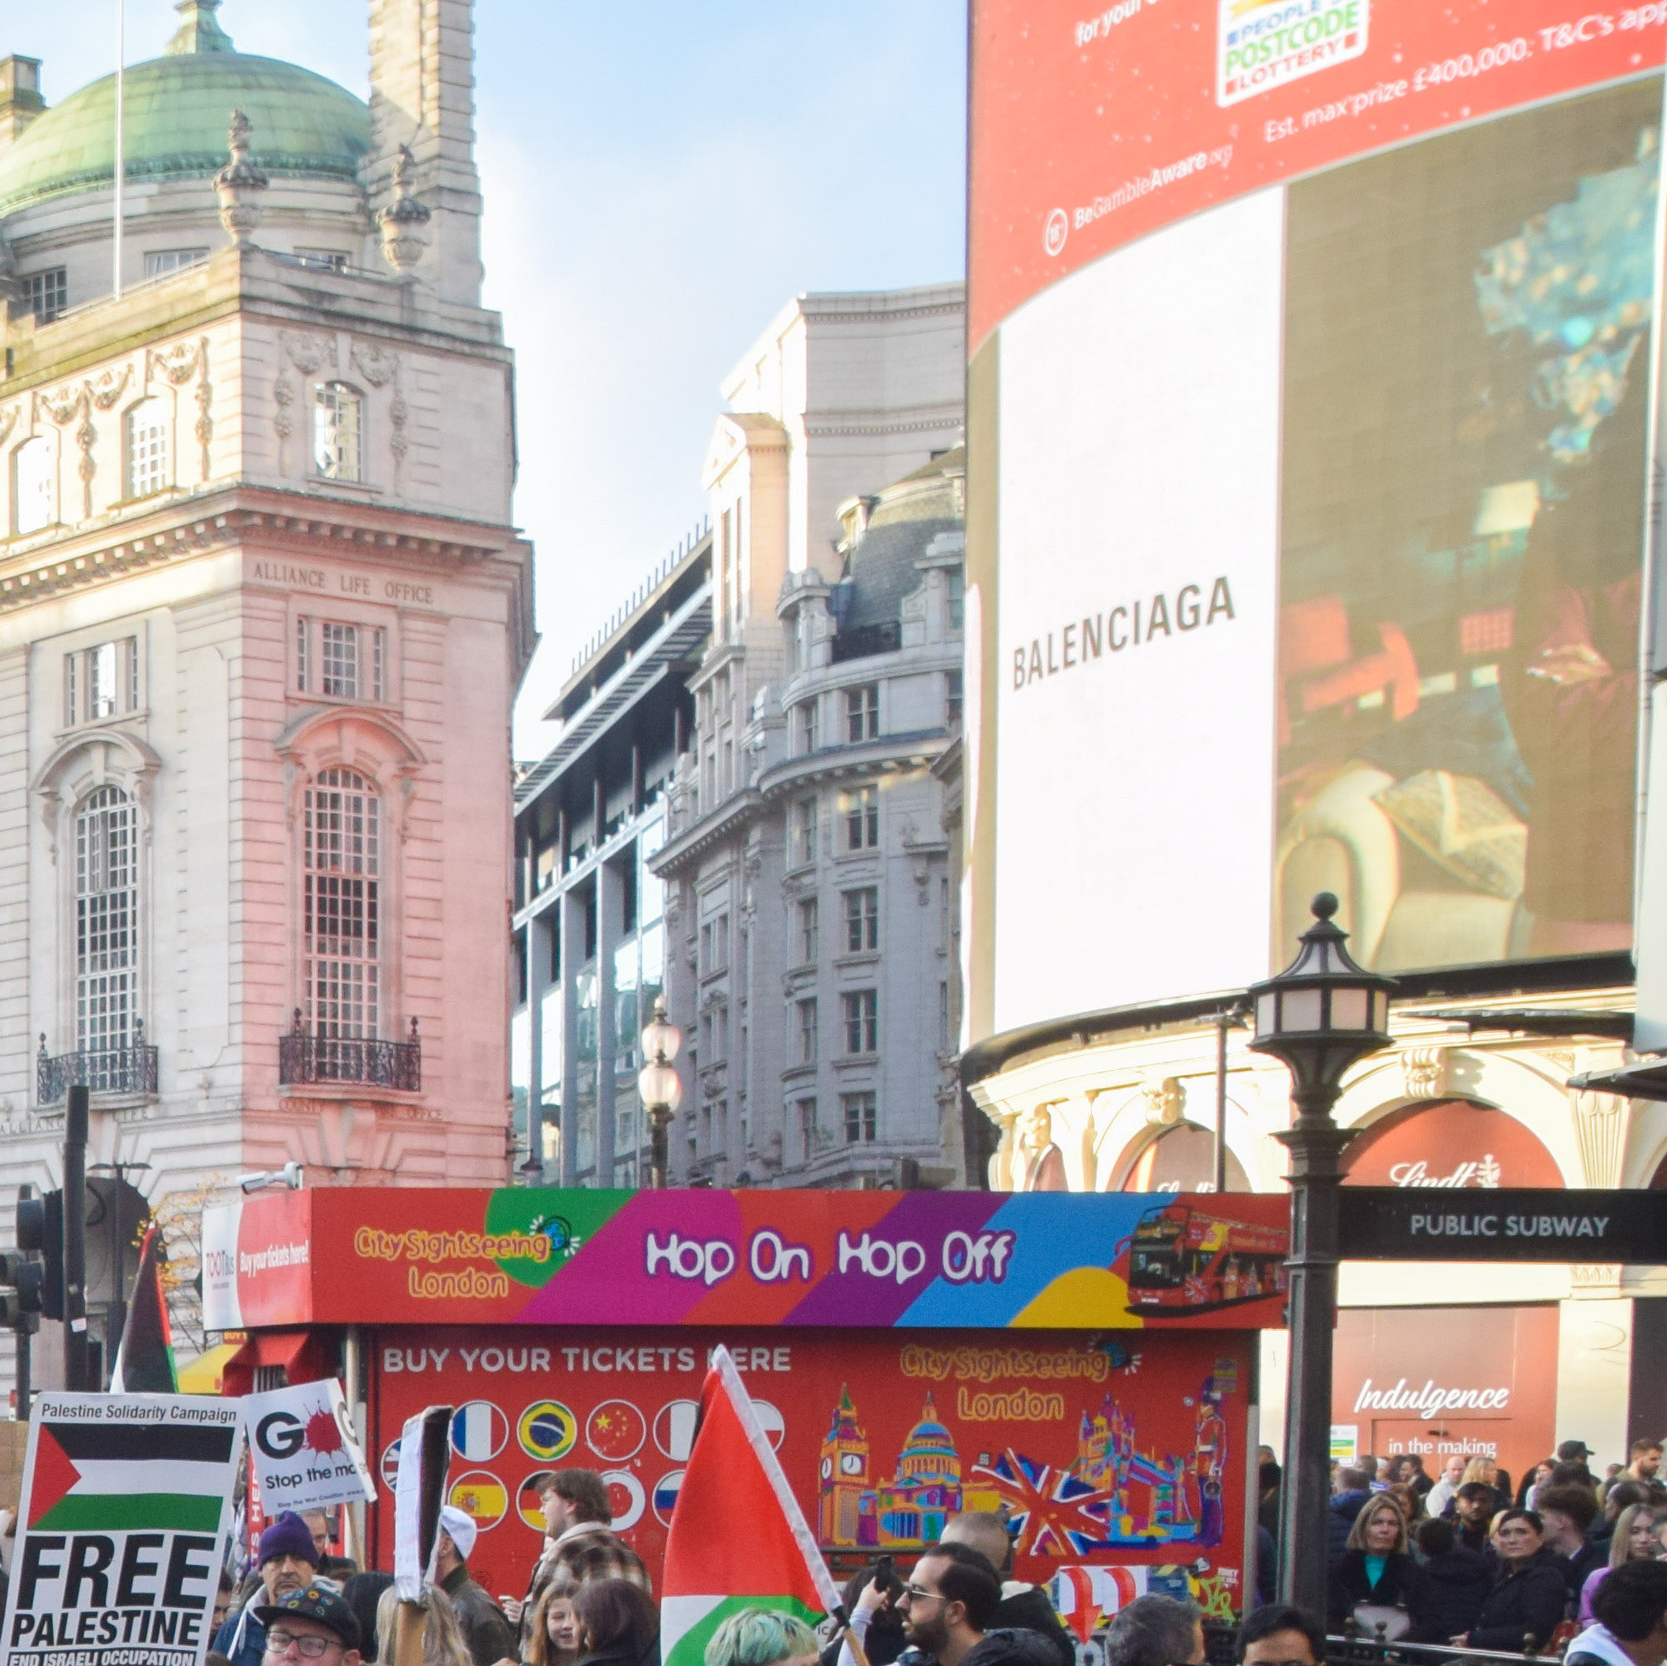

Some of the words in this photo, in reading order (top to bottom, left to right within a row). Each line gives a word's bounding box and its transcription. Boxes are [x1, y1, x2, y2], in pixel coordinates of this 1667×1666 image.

[1076, 20, 1100, 47] for
[1225, 2, 1359, 77] POSTCODE
[1238, 38, 1341, 91] LOTTERY
[1264, 113, 1299, 143] Est.
[1303, 101, 1348, 128] max
[1349, 78, 1407, 118] prize
[254, 562, 326, 589] ALLIANCE
[340, 575, 370, 596] LIFE
[385, 581, 434, 605] OFFICE
[1013, 575, 1236, 692] BALENCIAGA
[1410, 1213, 1498, 1238] PUBLIC
[1503, 1214, 1610, 1239] SUBWAY
[354, 1227, 404, 1262] City
[405, 1229, 551, 1264] Sightseeing
[646, 1231, 735, 1287] Hop
[750, 1230, 810, 1280] On
[838, 1231, 926, 1285] Hop
[942, 1230, 1014, 1281] Off
[407, 1267, 509, 1298] London
[383, 1347, 450, 1374] BUY
[459, 1347, 551, 1374] YOUR
[563, 1347, 697, 1374] TICKETS
[899, 1344, 952, 1379] City
[954, 1346, 1110, 1380] Sightseeing
[41, 1403, 103, 1419] Palestine
[105, 1404, 167, 1422] Solidarity
[170, 1405, 237, 1424] Campaign
[957, 1388, 1064, 1420] London
[1353, 1378, 1509, 1420] Indulgence
[1388, 1438, 1404, 1454] in
[1407, 1438, 1433, 1455] the
[1436, 1438, 1497, 1459] making
[265, 1470, 303, 1490] Stop
[306, 1467, 332, 1482] the
[16, 1533, 217, 1611] FREE
[9, 1609, 203, 1648] PALESTINE
